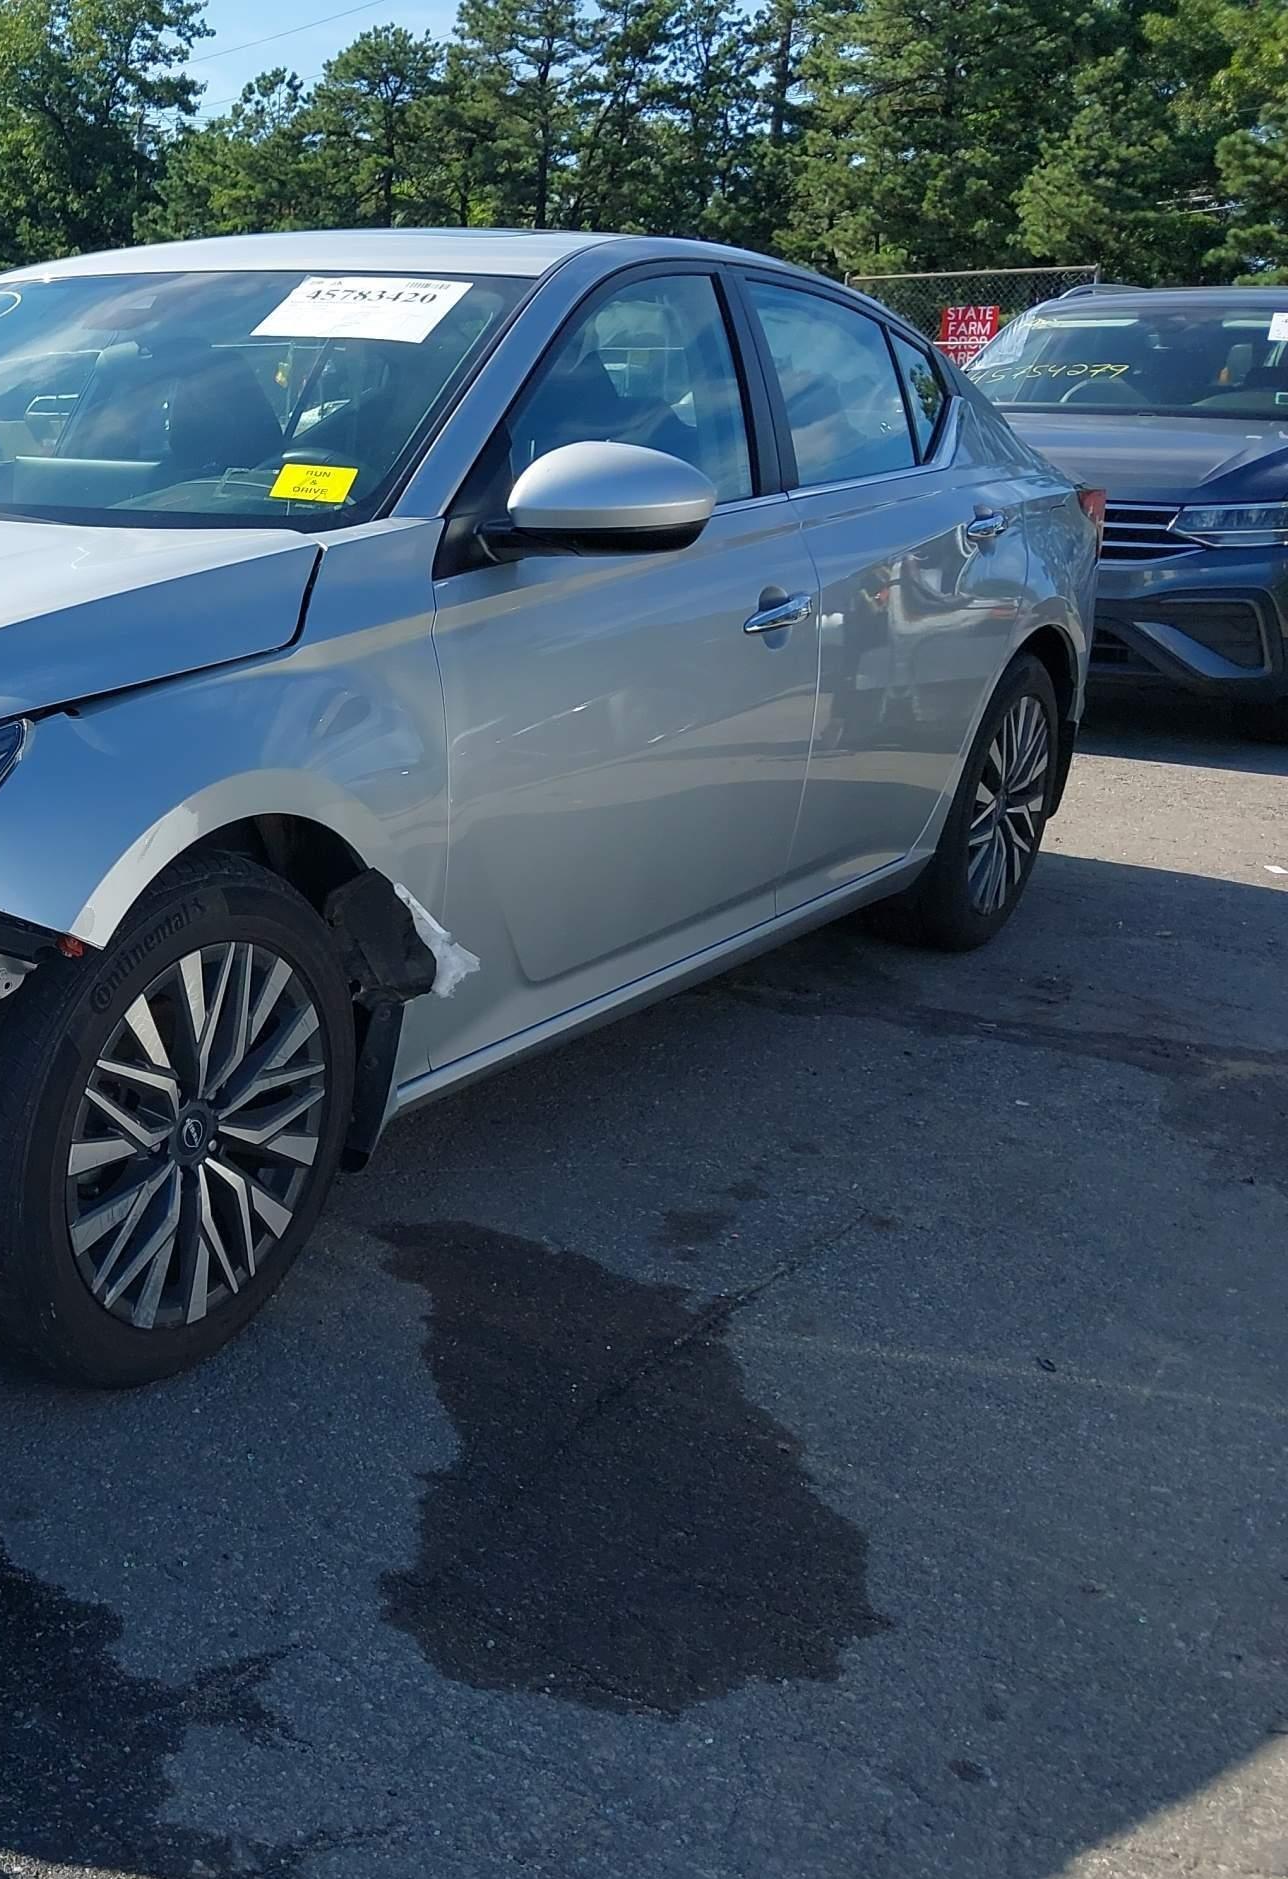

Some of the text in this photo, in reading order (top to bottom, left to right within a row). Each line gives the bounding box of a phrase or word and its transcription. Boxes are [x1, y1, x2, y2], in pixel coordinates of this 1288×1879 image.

[305, 289, 438, 304] 45783420
[947, 306, 994, 321] STATE
[947, 322, 991, 336] FARM
[948, 351, 975, 366] ARE
[306, 470, 331, 478] RUN
[292, 486, 328, 495] DRIVE
